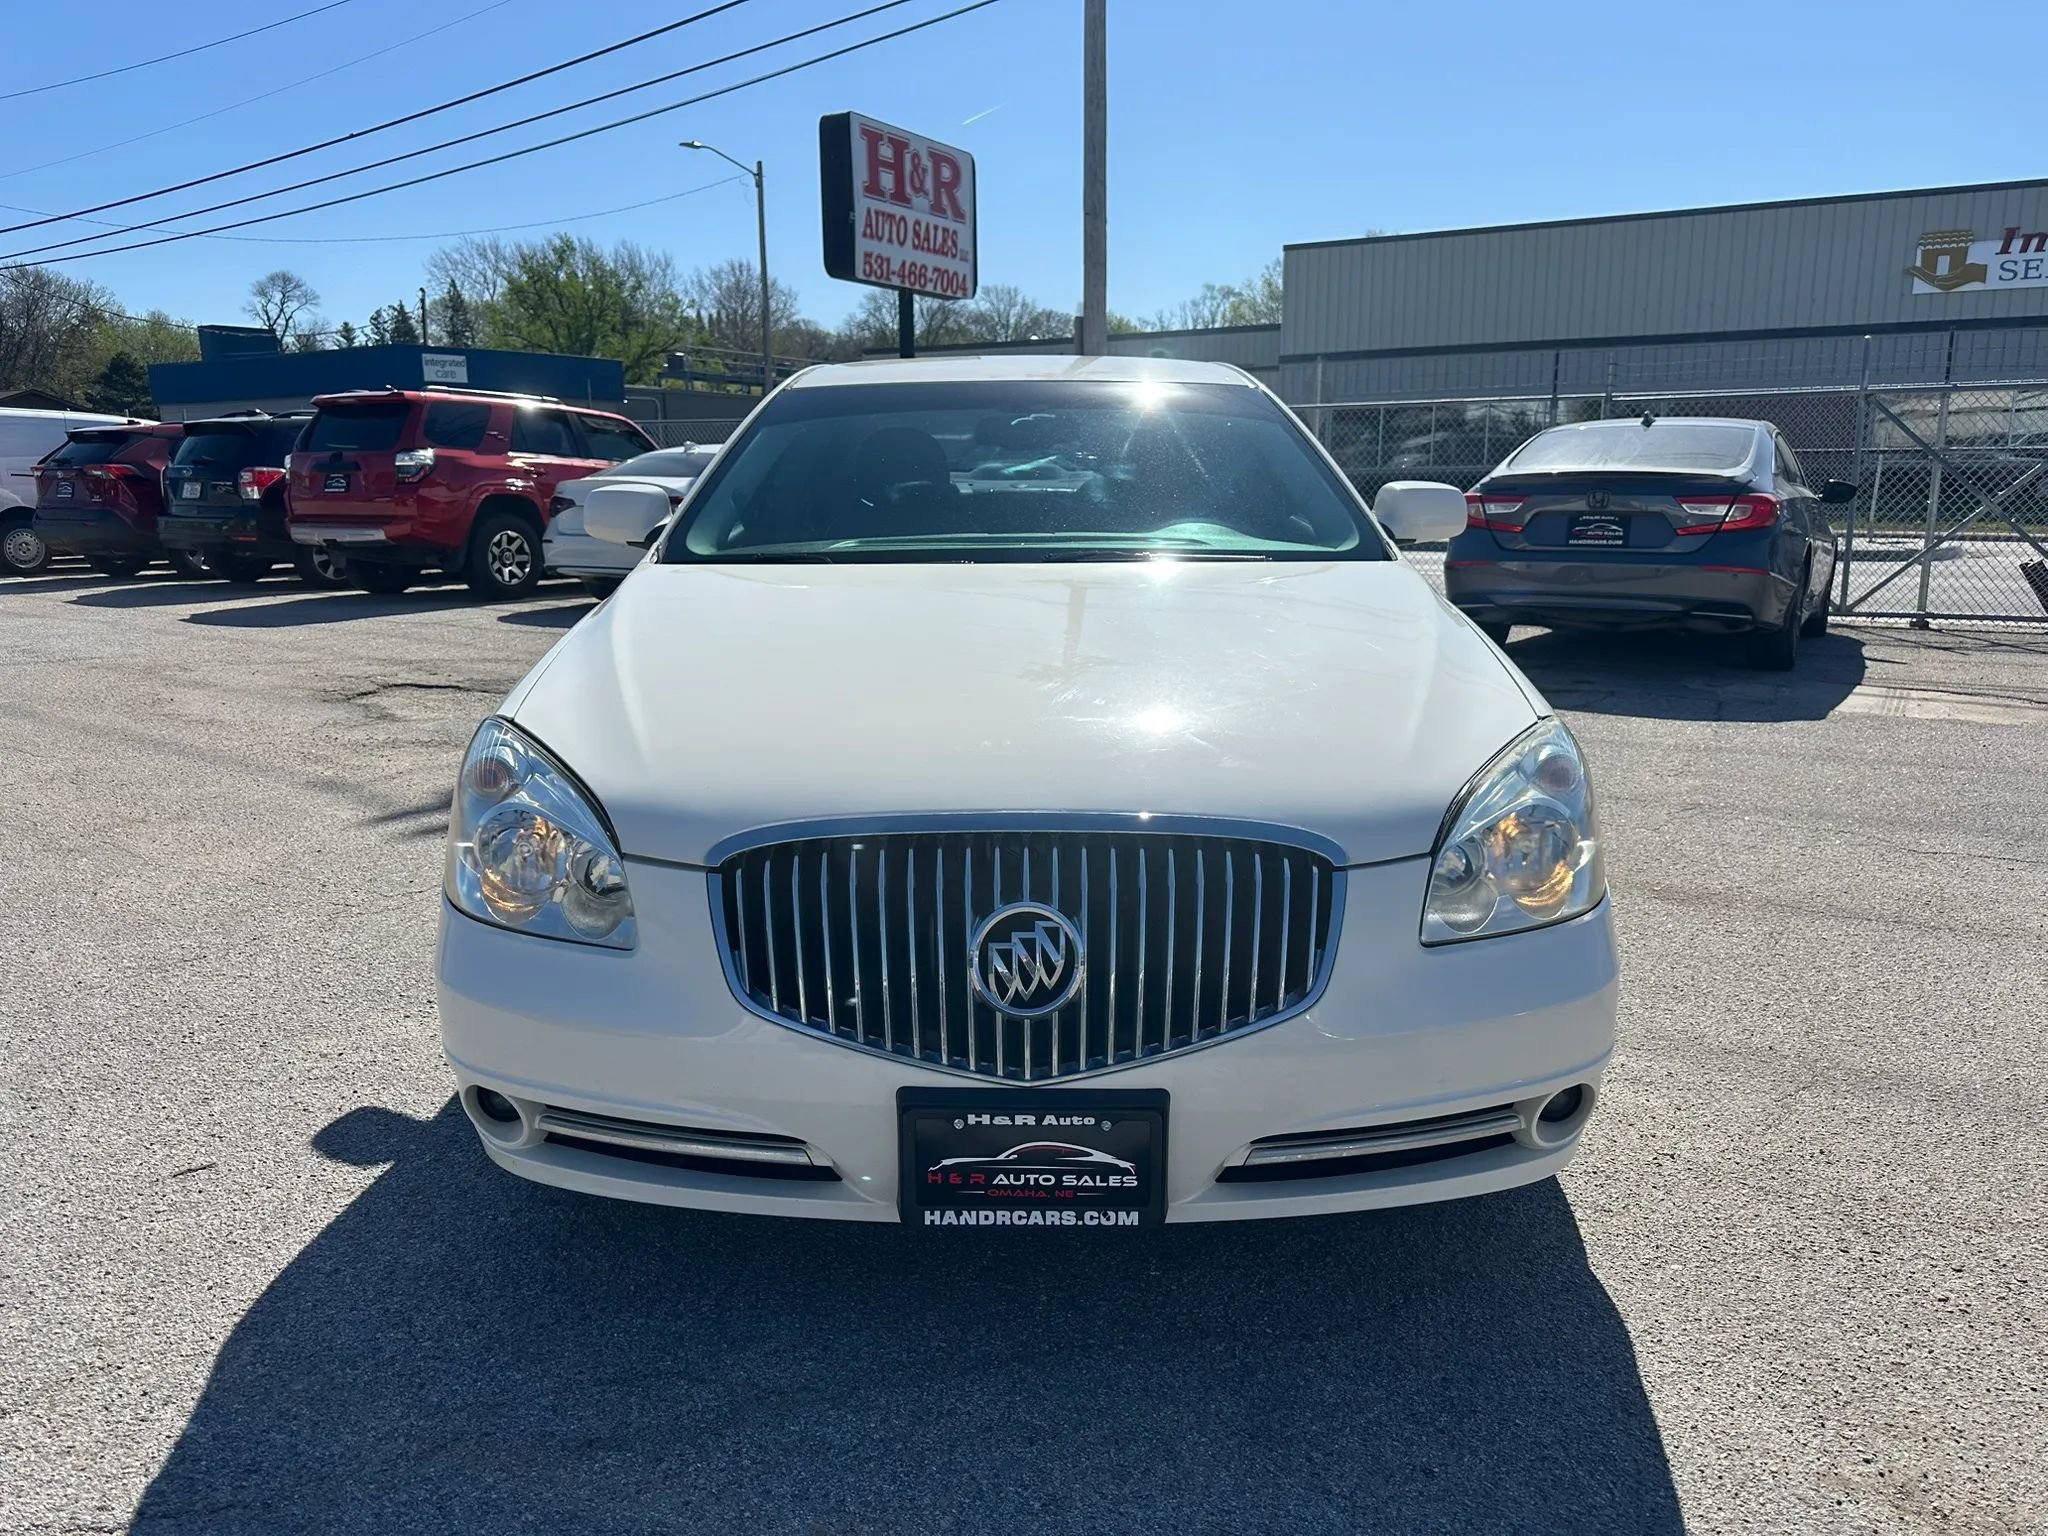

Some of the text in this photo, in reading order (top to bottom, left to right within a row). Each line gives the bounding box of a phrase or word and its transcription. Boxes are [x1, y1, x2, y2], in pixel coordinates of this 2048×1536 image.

[859, 123, 966, 224] H&R
[862, 207, 959, 262] AUTO SALES
[863, 251, 968, 296] 531-466-7004
[1998, 258, 2048, 281] SE
[435, 369, 457, 379] care
[967, 1114, 1096, 1126] H&R Auto
[927, 1173, 1138, 1187] H & R AUTO SALES
[987, 1189, 1074, 1198] OMAHA, NE
[924, 1210, 1139, 1226] HANDRCARS.COM
